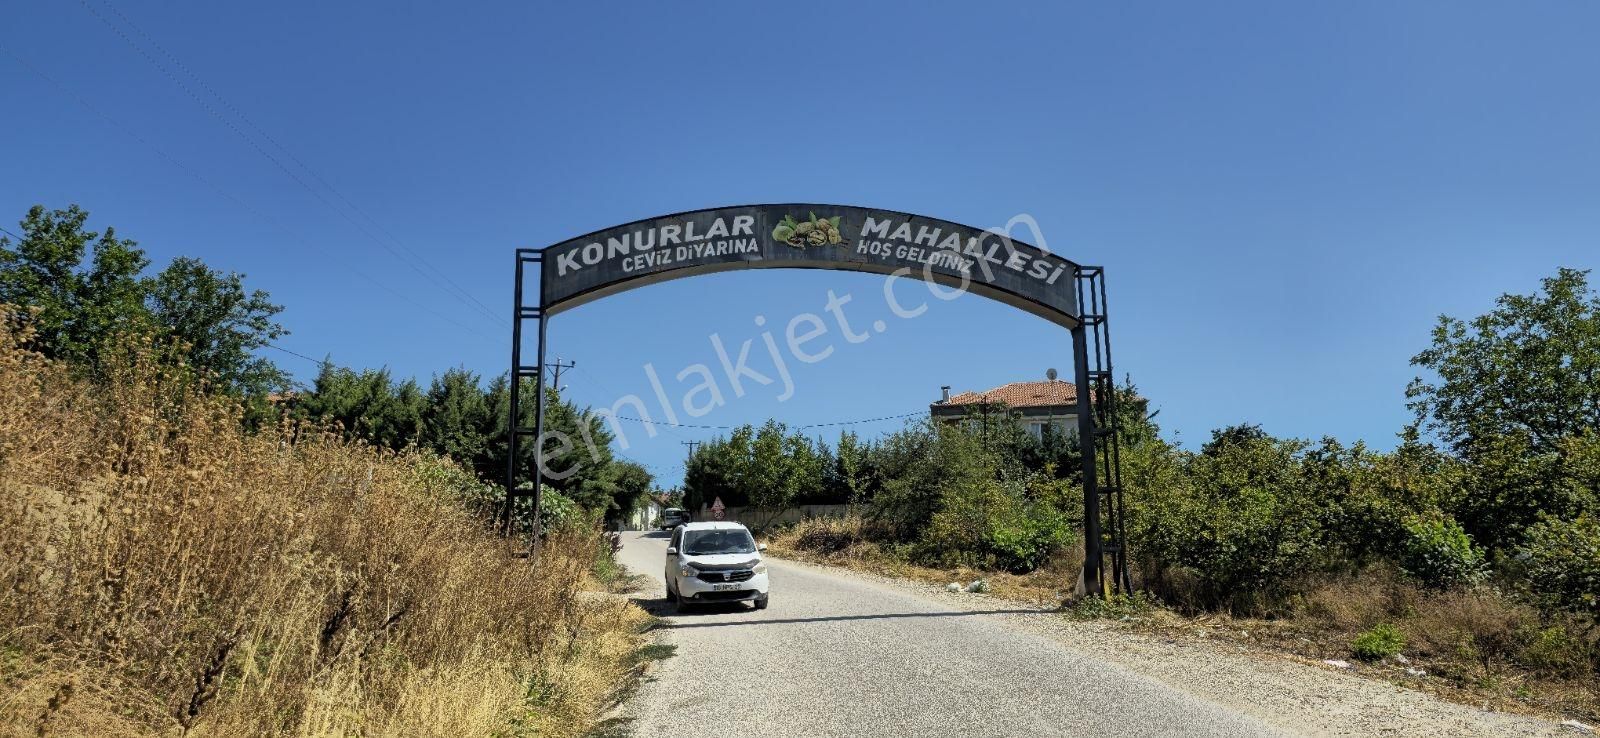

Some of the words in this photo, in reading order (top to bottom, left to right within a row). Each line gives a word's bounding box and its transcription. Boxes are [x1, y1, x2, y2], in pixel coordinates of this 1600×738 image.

[556, 215, 755, 277] KONURLAR
[860, 217, 1067, 284] MAHALLESİ
[856, 239, 893, 260] HOŞ
